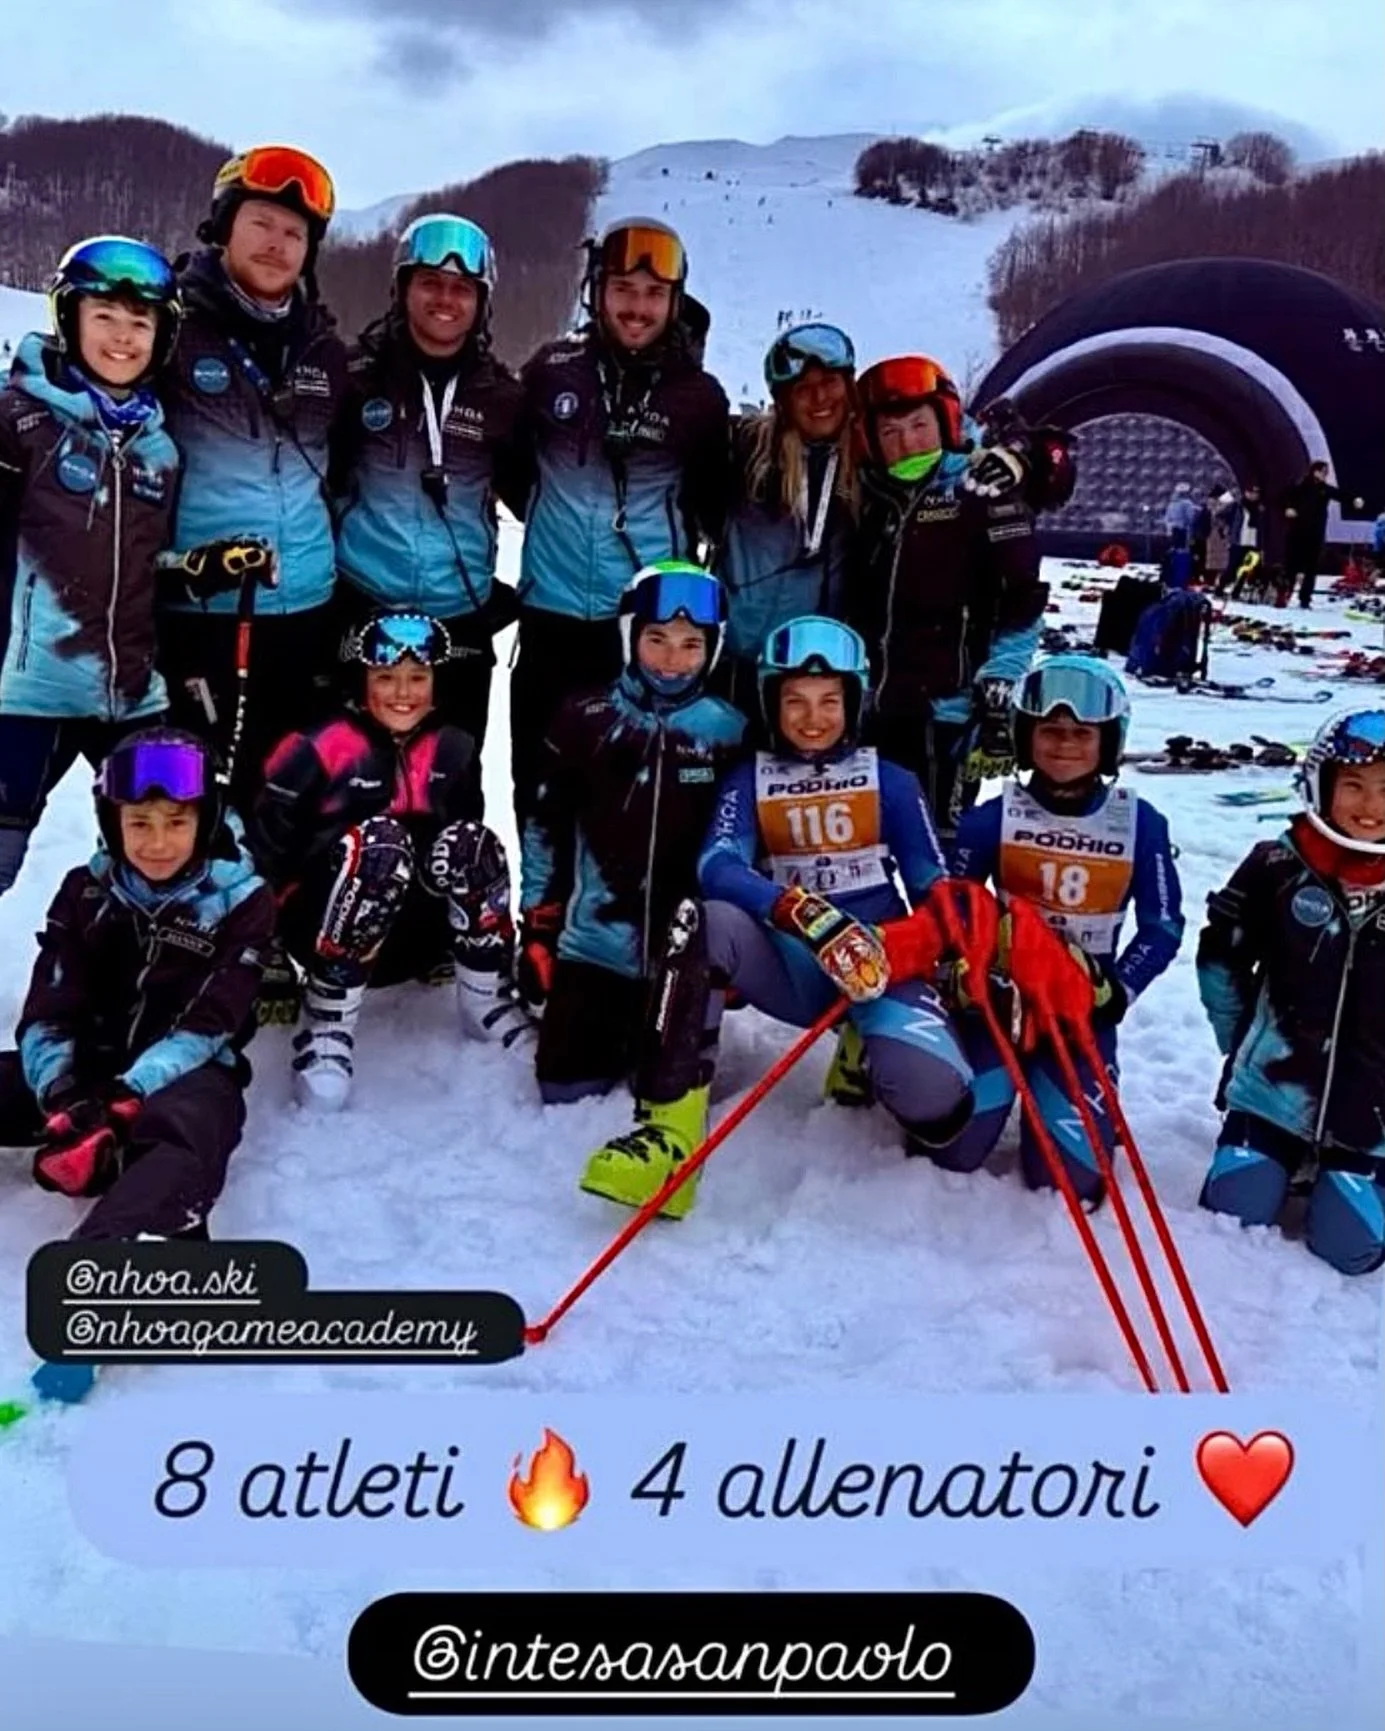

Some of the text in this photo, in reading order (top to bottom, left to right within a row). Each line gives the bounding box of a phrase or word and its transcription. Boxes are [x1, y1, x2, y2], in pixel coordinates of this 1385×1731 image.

[786, 802, 855, 847] 116
[1014, 830, 1125, 855] PODHIO
[1039, 862, 1090, 907] 18
